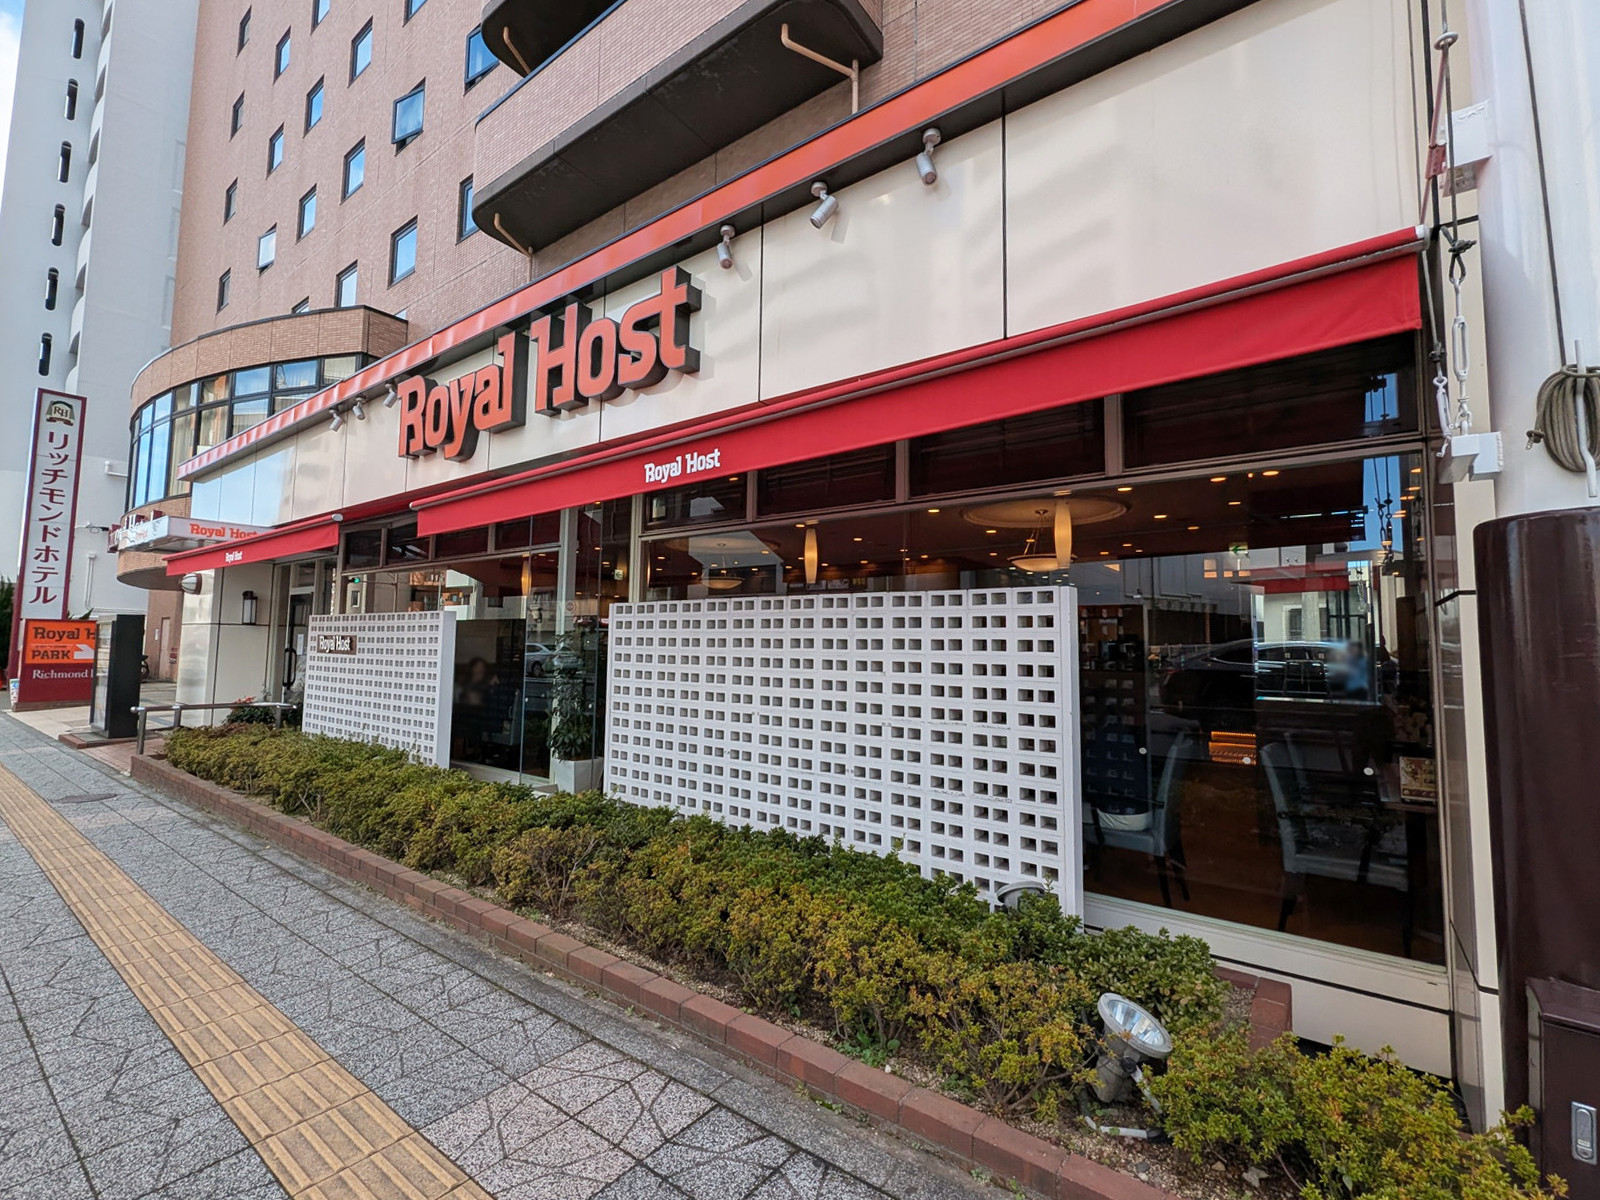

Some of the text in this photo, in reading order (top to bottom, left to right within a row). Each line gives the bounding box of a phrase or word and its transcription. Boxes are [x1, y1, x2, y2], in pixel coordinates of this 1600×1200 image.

[398, 265, 695, 461] Royal Host
[644, 448, 721, 483] Royal Host
[29, 431, 69, 604] リッチモンドホテル
[189, 523, 226, 538] Royal
[33, 626, 80, 642] Royal
[319, 635, 350, 653] Royal Host
[31, 650, 71, 660] PARK
[32, 669, 89, 679] Richmond
